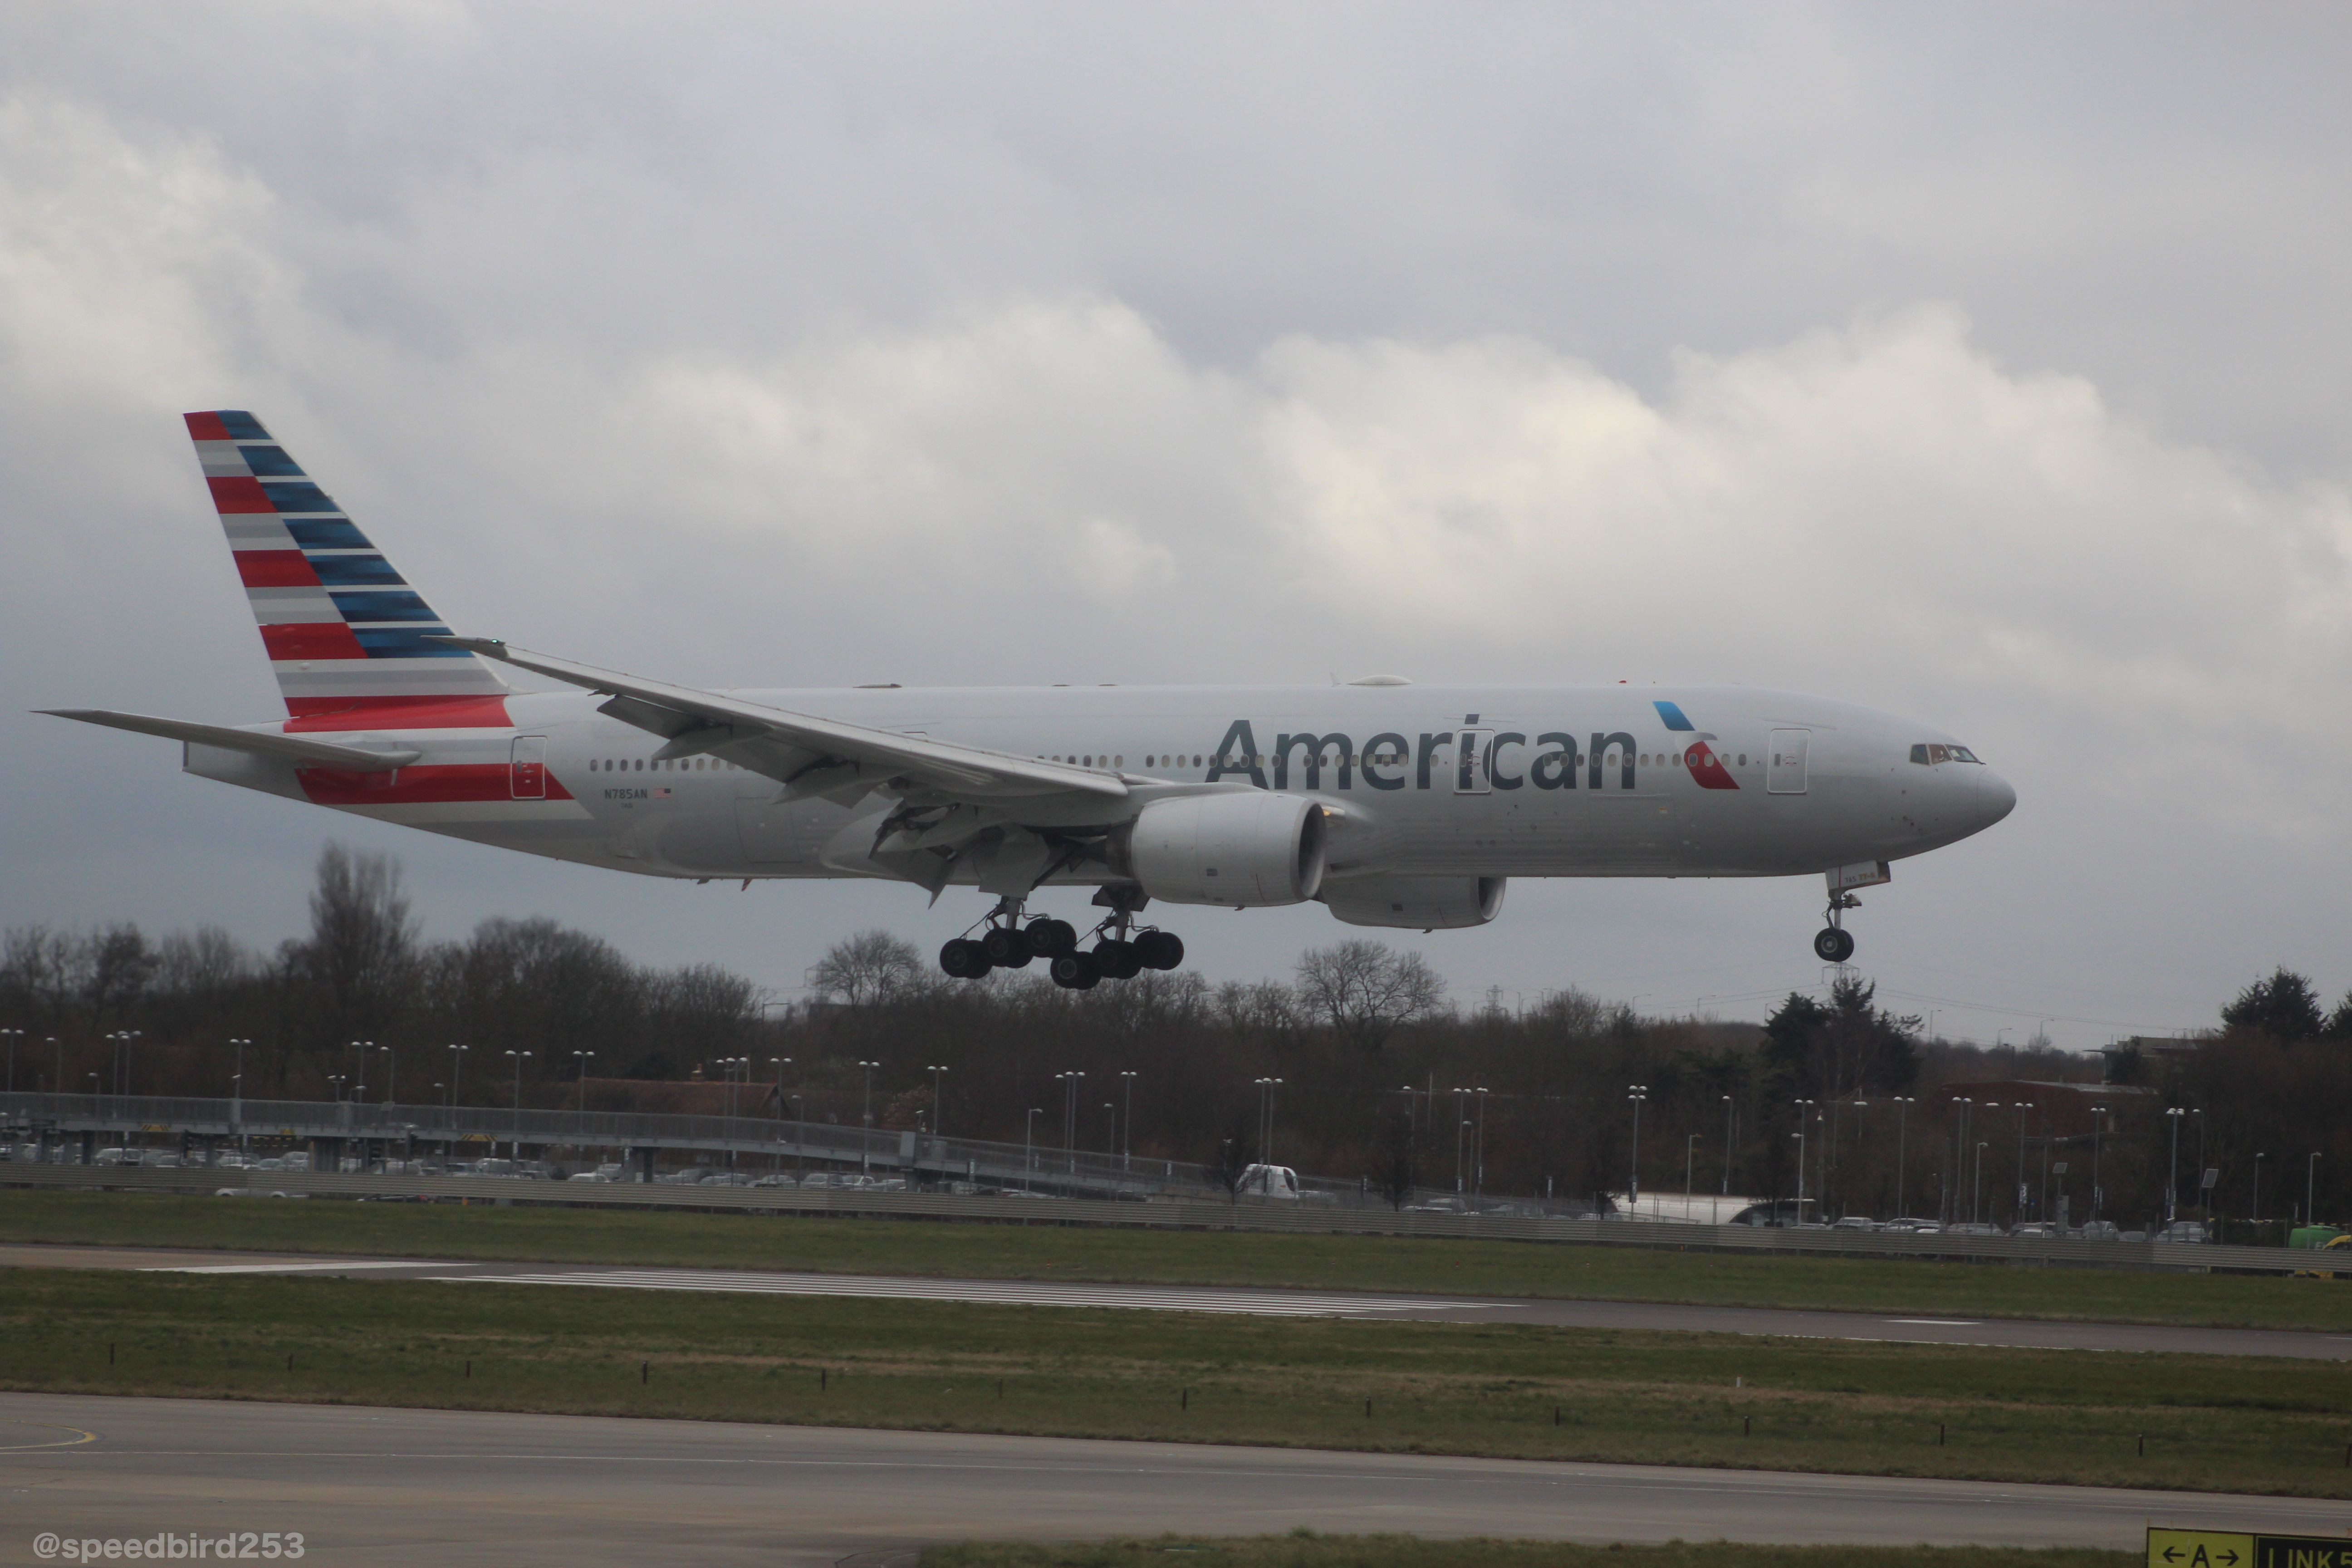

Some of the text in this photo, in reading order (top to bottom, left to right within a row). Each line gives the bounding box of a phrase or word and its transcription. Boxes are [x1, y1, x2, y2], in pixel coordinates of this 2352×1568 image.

[1205, 713, 1636, 790] American
[605, 788, 647, 799] N785AN
[2190, 1544, 2210, 1568] A
